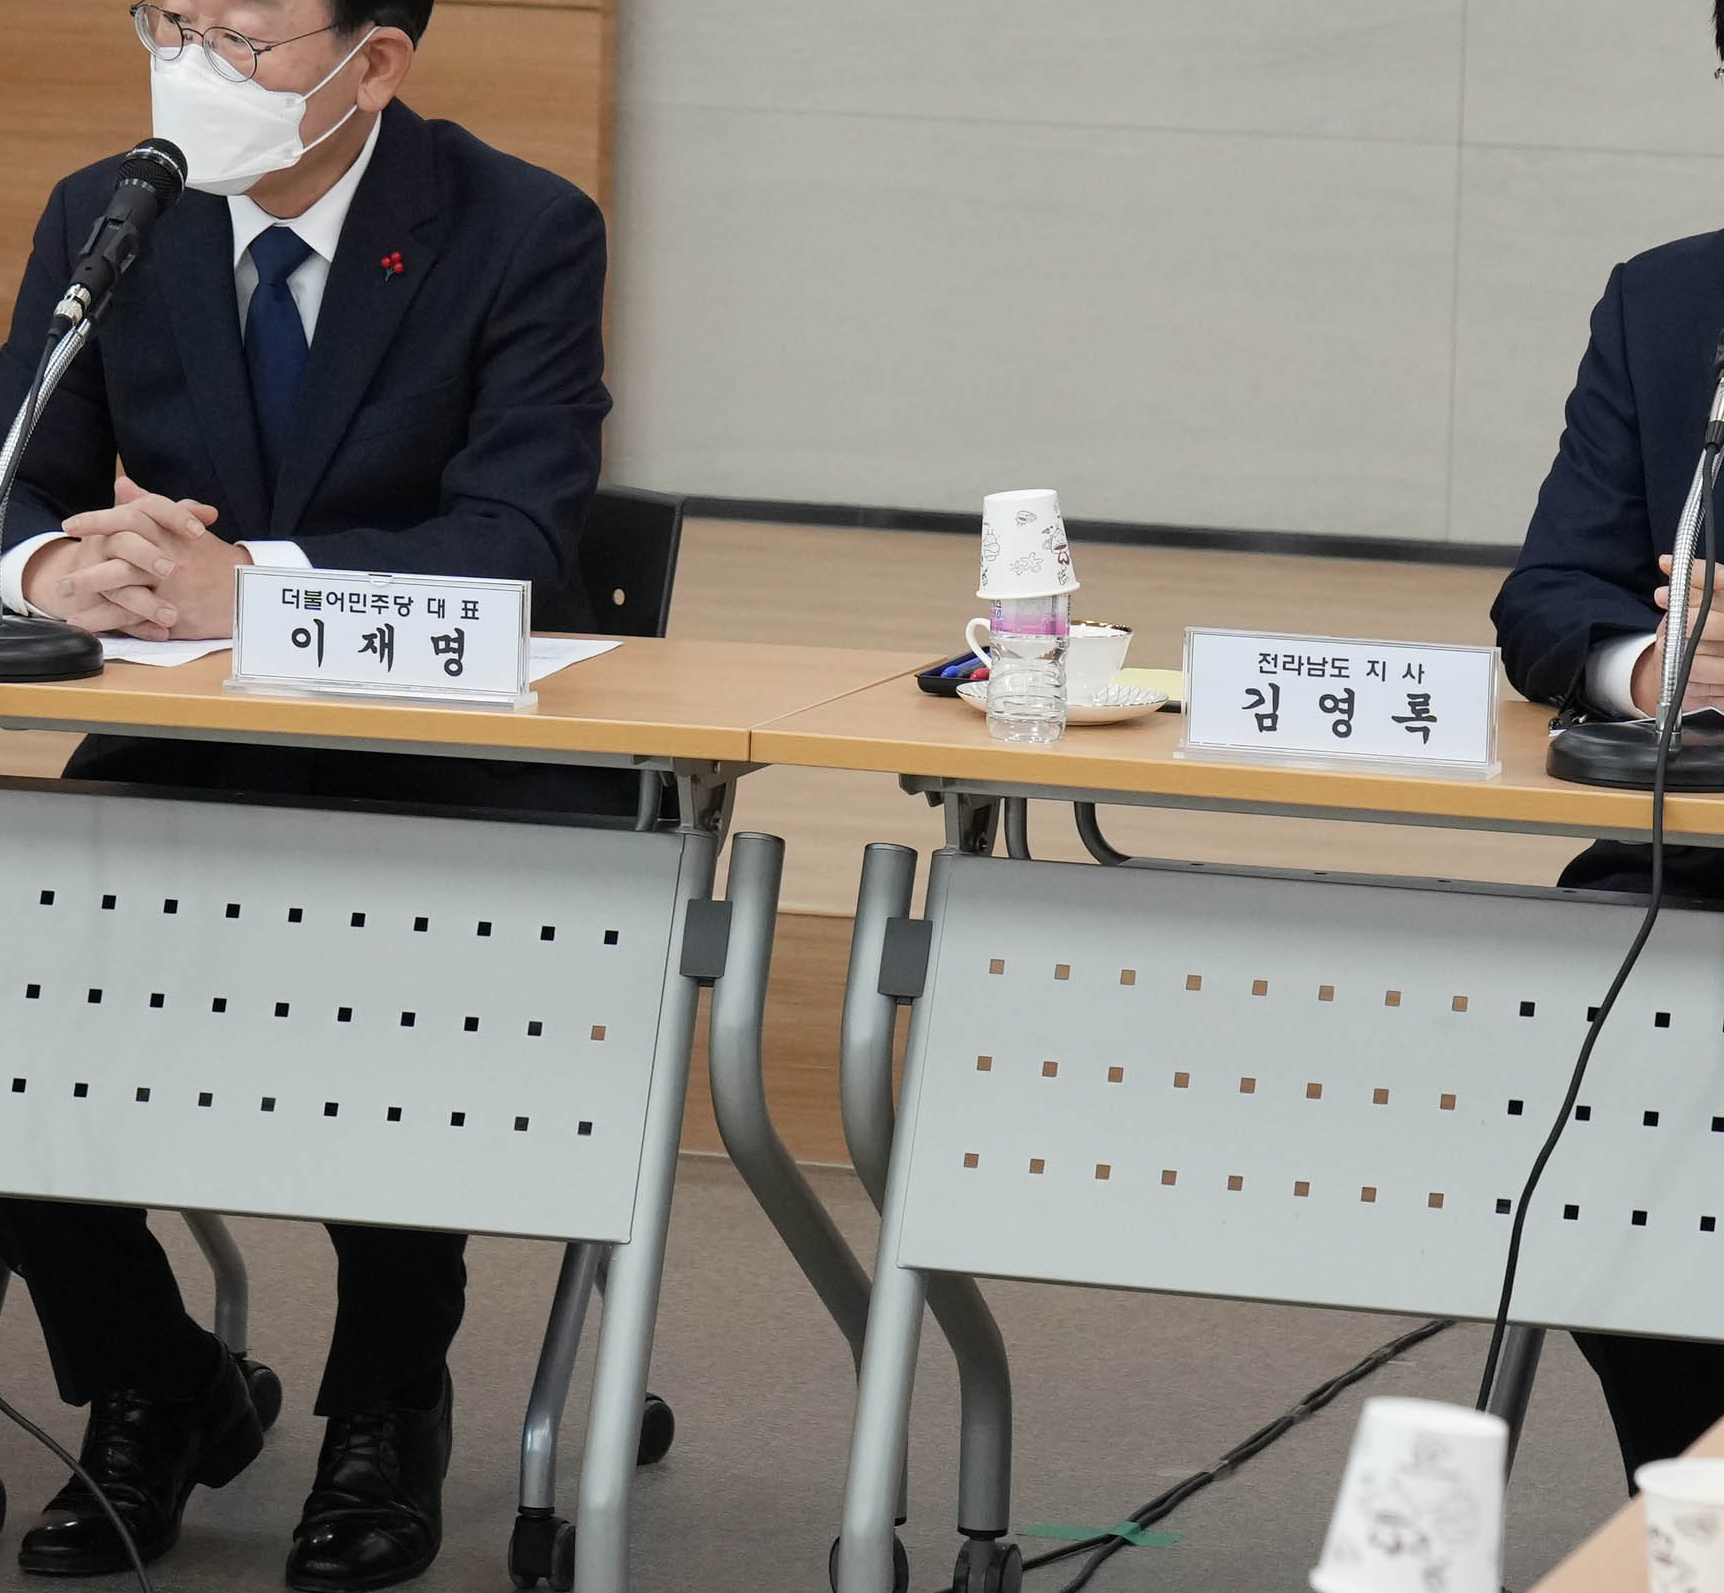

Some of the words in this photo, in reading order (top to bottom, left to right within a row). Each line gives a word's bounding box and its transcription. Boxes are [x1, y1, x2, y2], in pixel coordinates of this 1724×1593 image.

[281, 588, 414, 617] 더불어민주당
[291, 618, 465, 677] 이재명
[1258, 651, 1351, 679] 전라남도
[1241, 682, 1438, 745] 김영록
